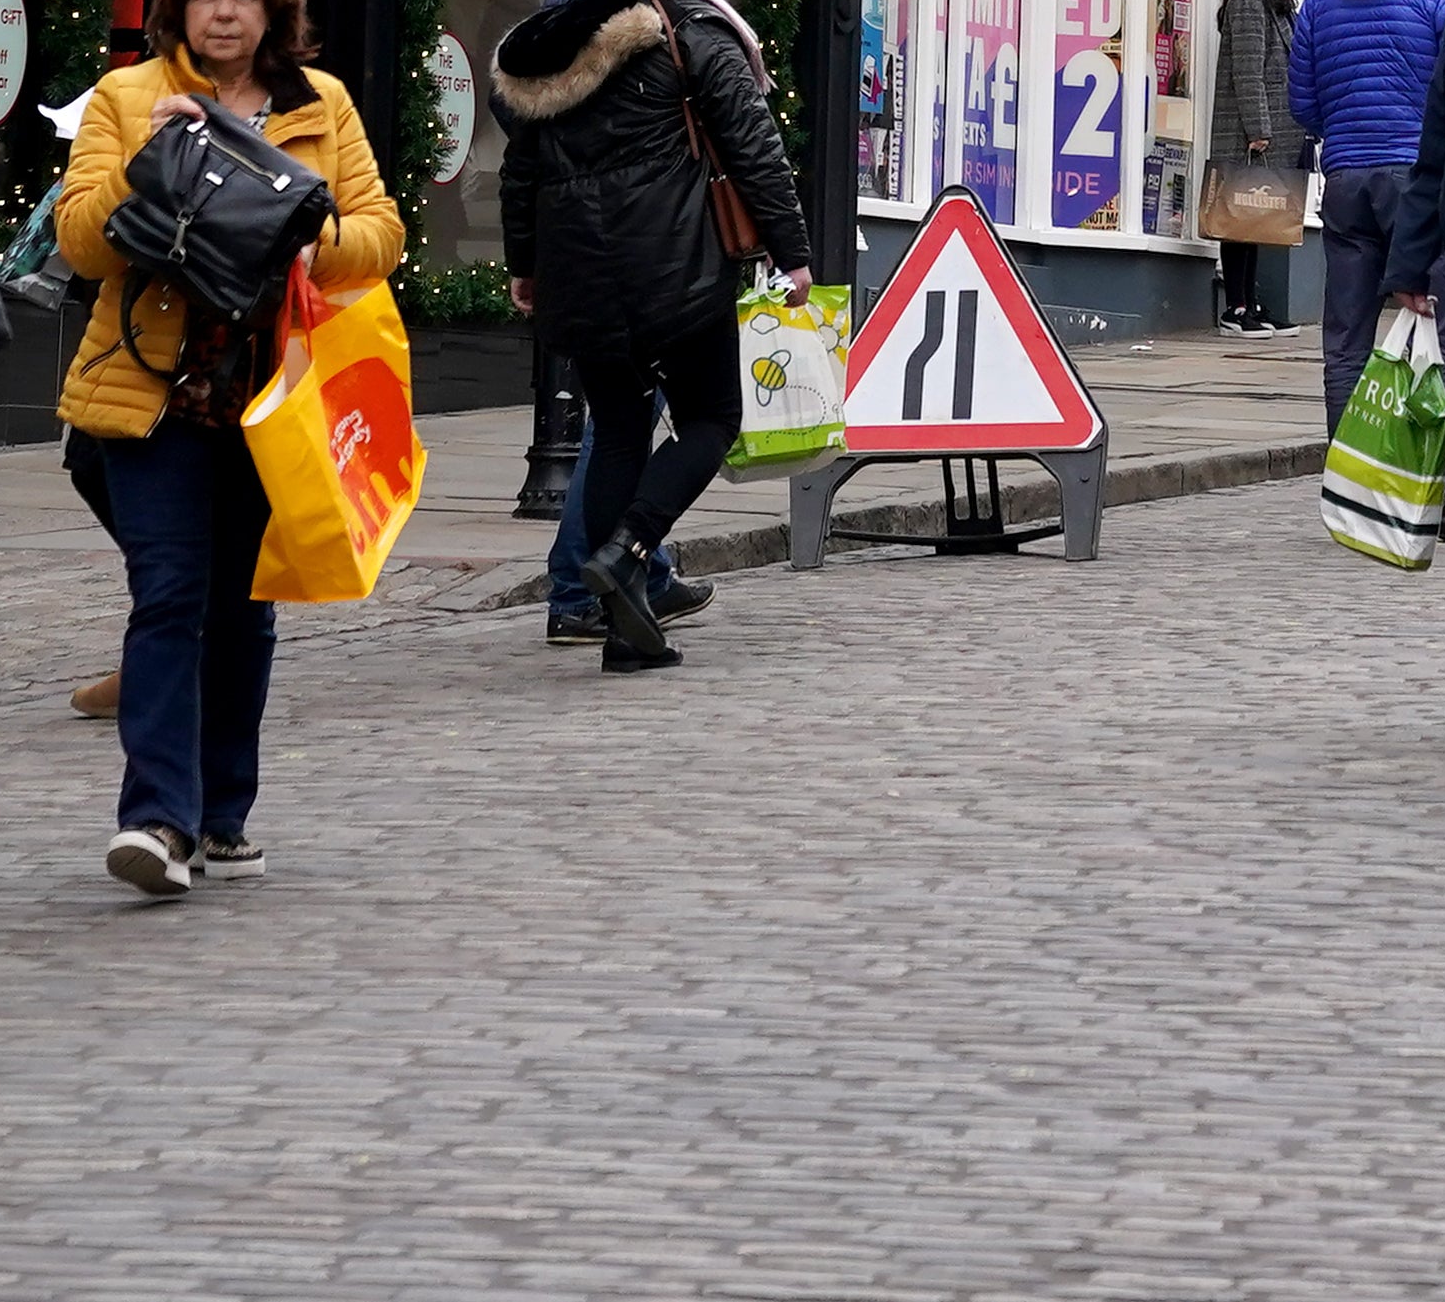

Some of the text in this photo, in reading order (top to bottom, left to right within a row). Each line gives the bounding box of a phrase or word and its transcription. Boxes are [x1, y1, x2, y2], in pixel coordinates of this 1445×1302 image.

[1, 9, 23, 26] GIFT
[439, 54, 453, 69] THE
[454, 78, 471, 93] GIFT
[1235, 192, 1287, 210] HOLLISTER
